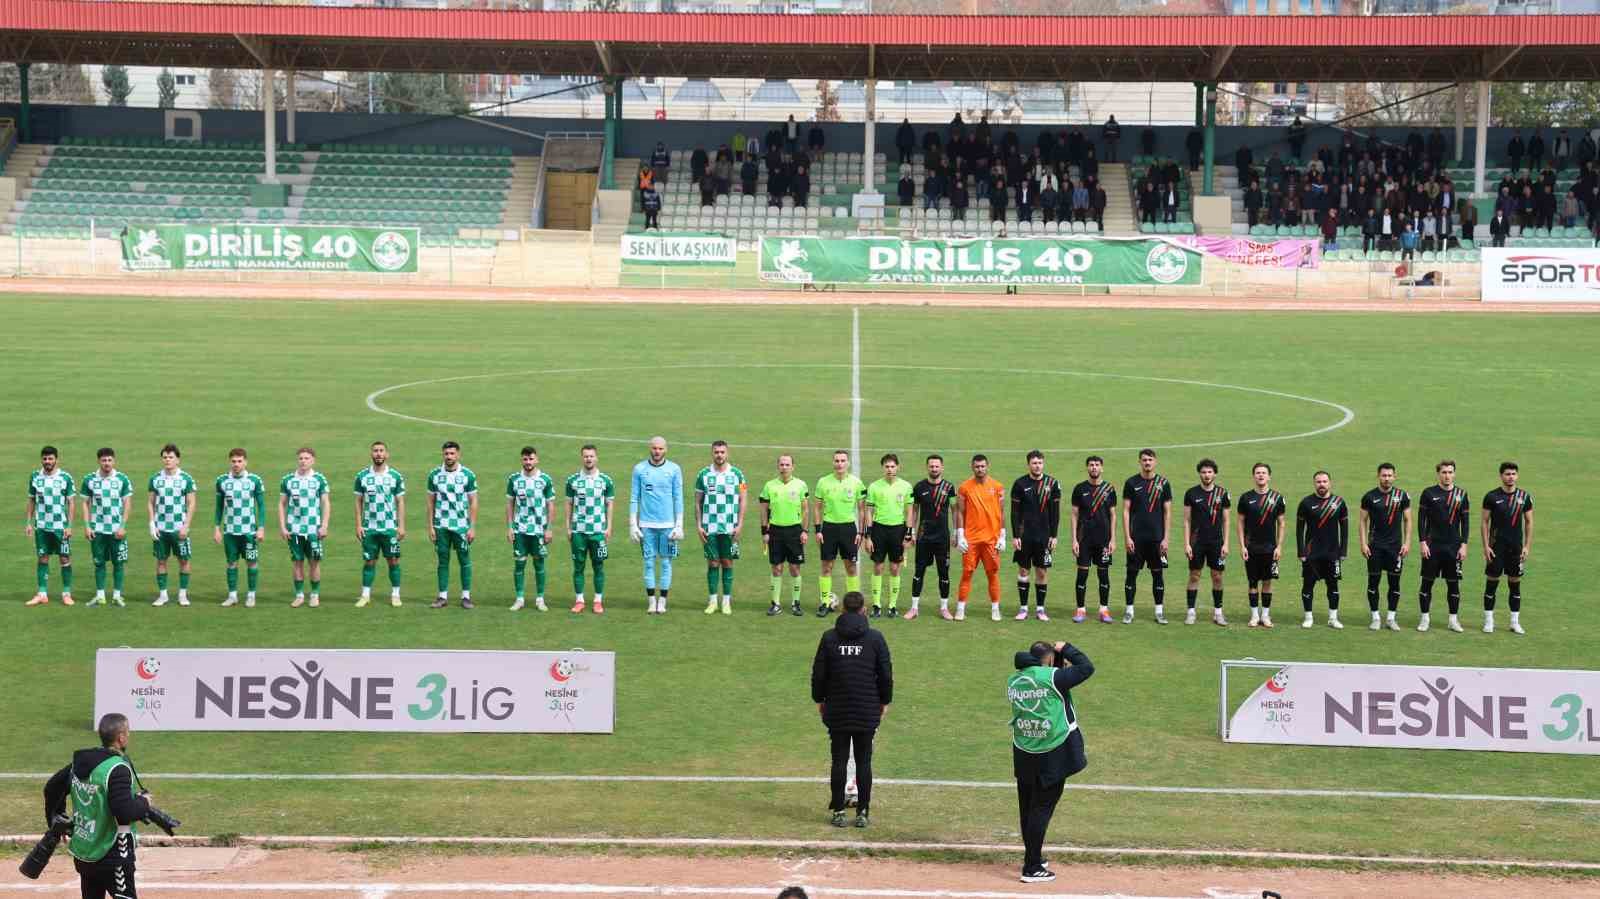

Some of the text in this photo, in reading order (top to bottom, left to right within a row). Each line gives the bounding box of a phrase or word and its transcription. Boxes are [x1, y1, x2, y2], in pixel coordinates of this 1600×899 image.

[185, 227, 304, 261] DİRİLİŞ
[311, 234, 357, 258] 40
[630, 239, 729, 260] SEN İLK AŞKIM
[868, 239, 1094, 275] DİRİLİŞ 40
[838, 645, 864, 656] TFF
[194, 659, 394, 719] NESİNE
[1323, 676, 1529, 741] NESİNE
